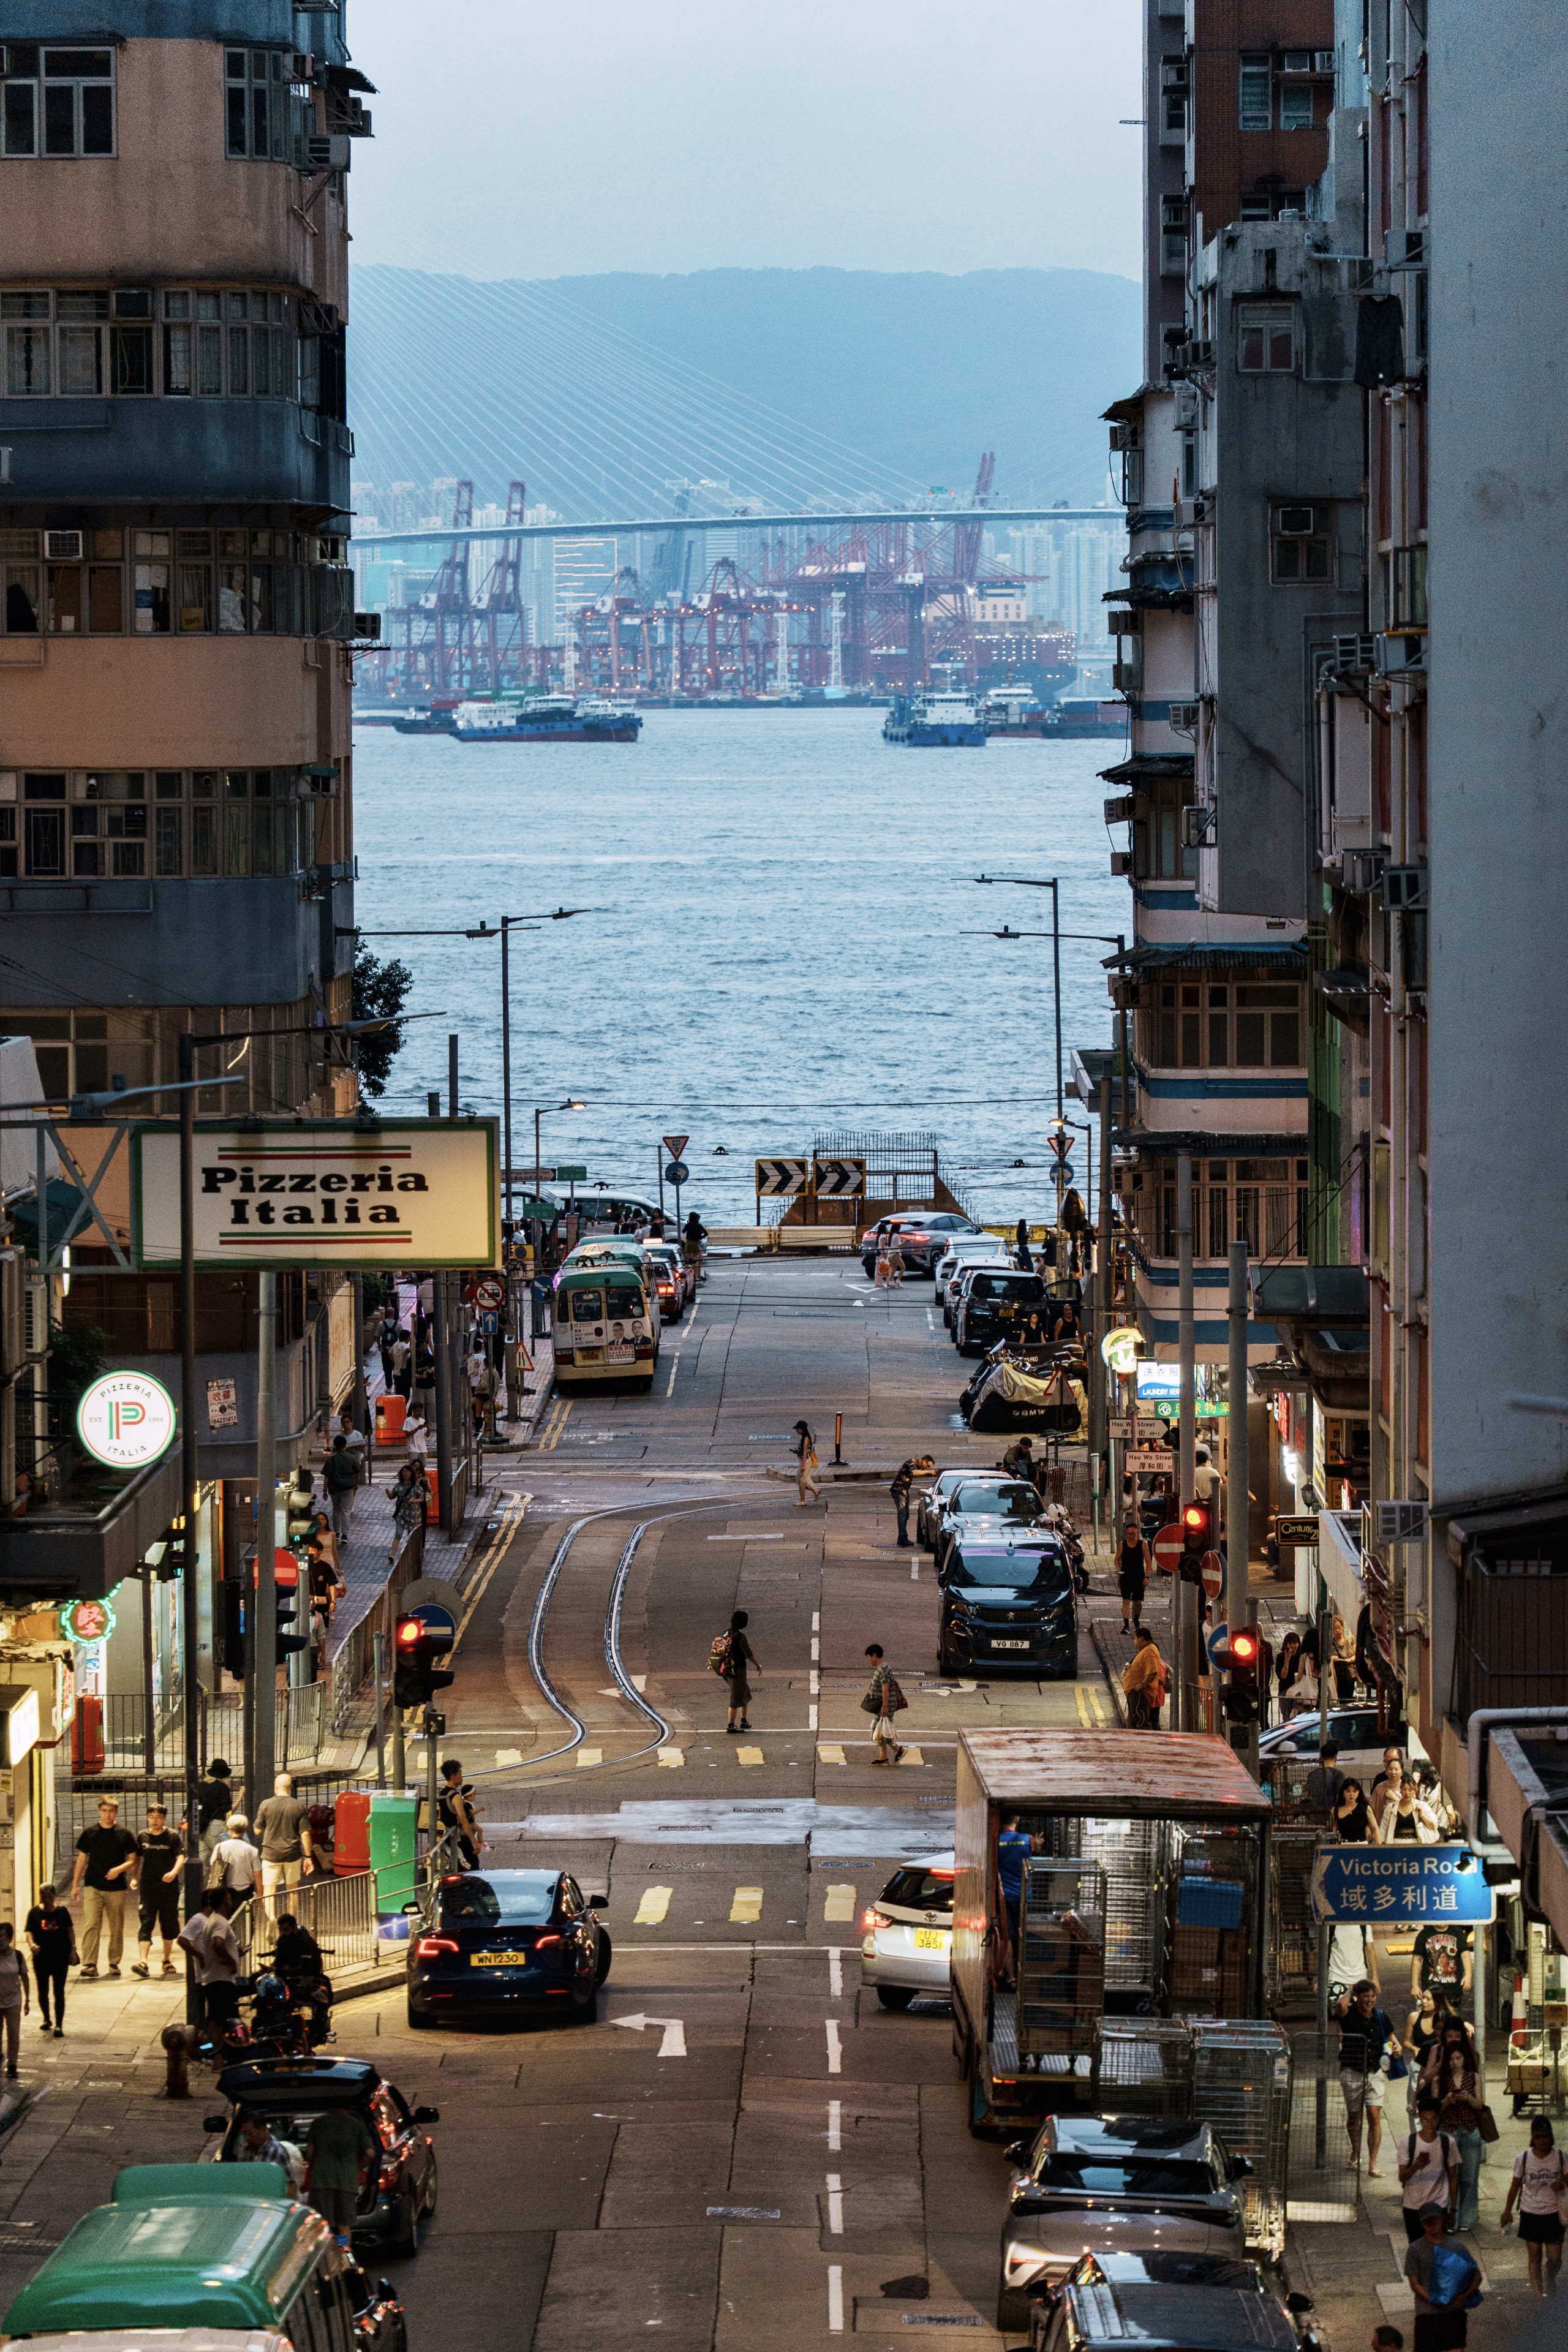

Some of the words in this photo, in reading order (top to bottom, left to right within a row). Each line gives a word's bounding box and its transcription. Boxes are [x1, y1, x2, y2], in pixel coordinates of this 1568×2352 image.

[202, 1165, 429, 1193] Pizzeria
[231, 1197, 400, 1224] Italia
[1144, 1367, 1178, 1377] 洗衣服
[100, 1384, 151, 1398] PIZZERIA
[108, 1446, 146, 1456] ITALIA
[1281, 1523, 1313, 1534] Century
[1340, 1858, 1420, 1875] Victoria
[1340, 1885, 1458, 1911] 域多利道
[924, 1931, 938, 1940] UJ
[918, 1939, 941, 1949] 3851
